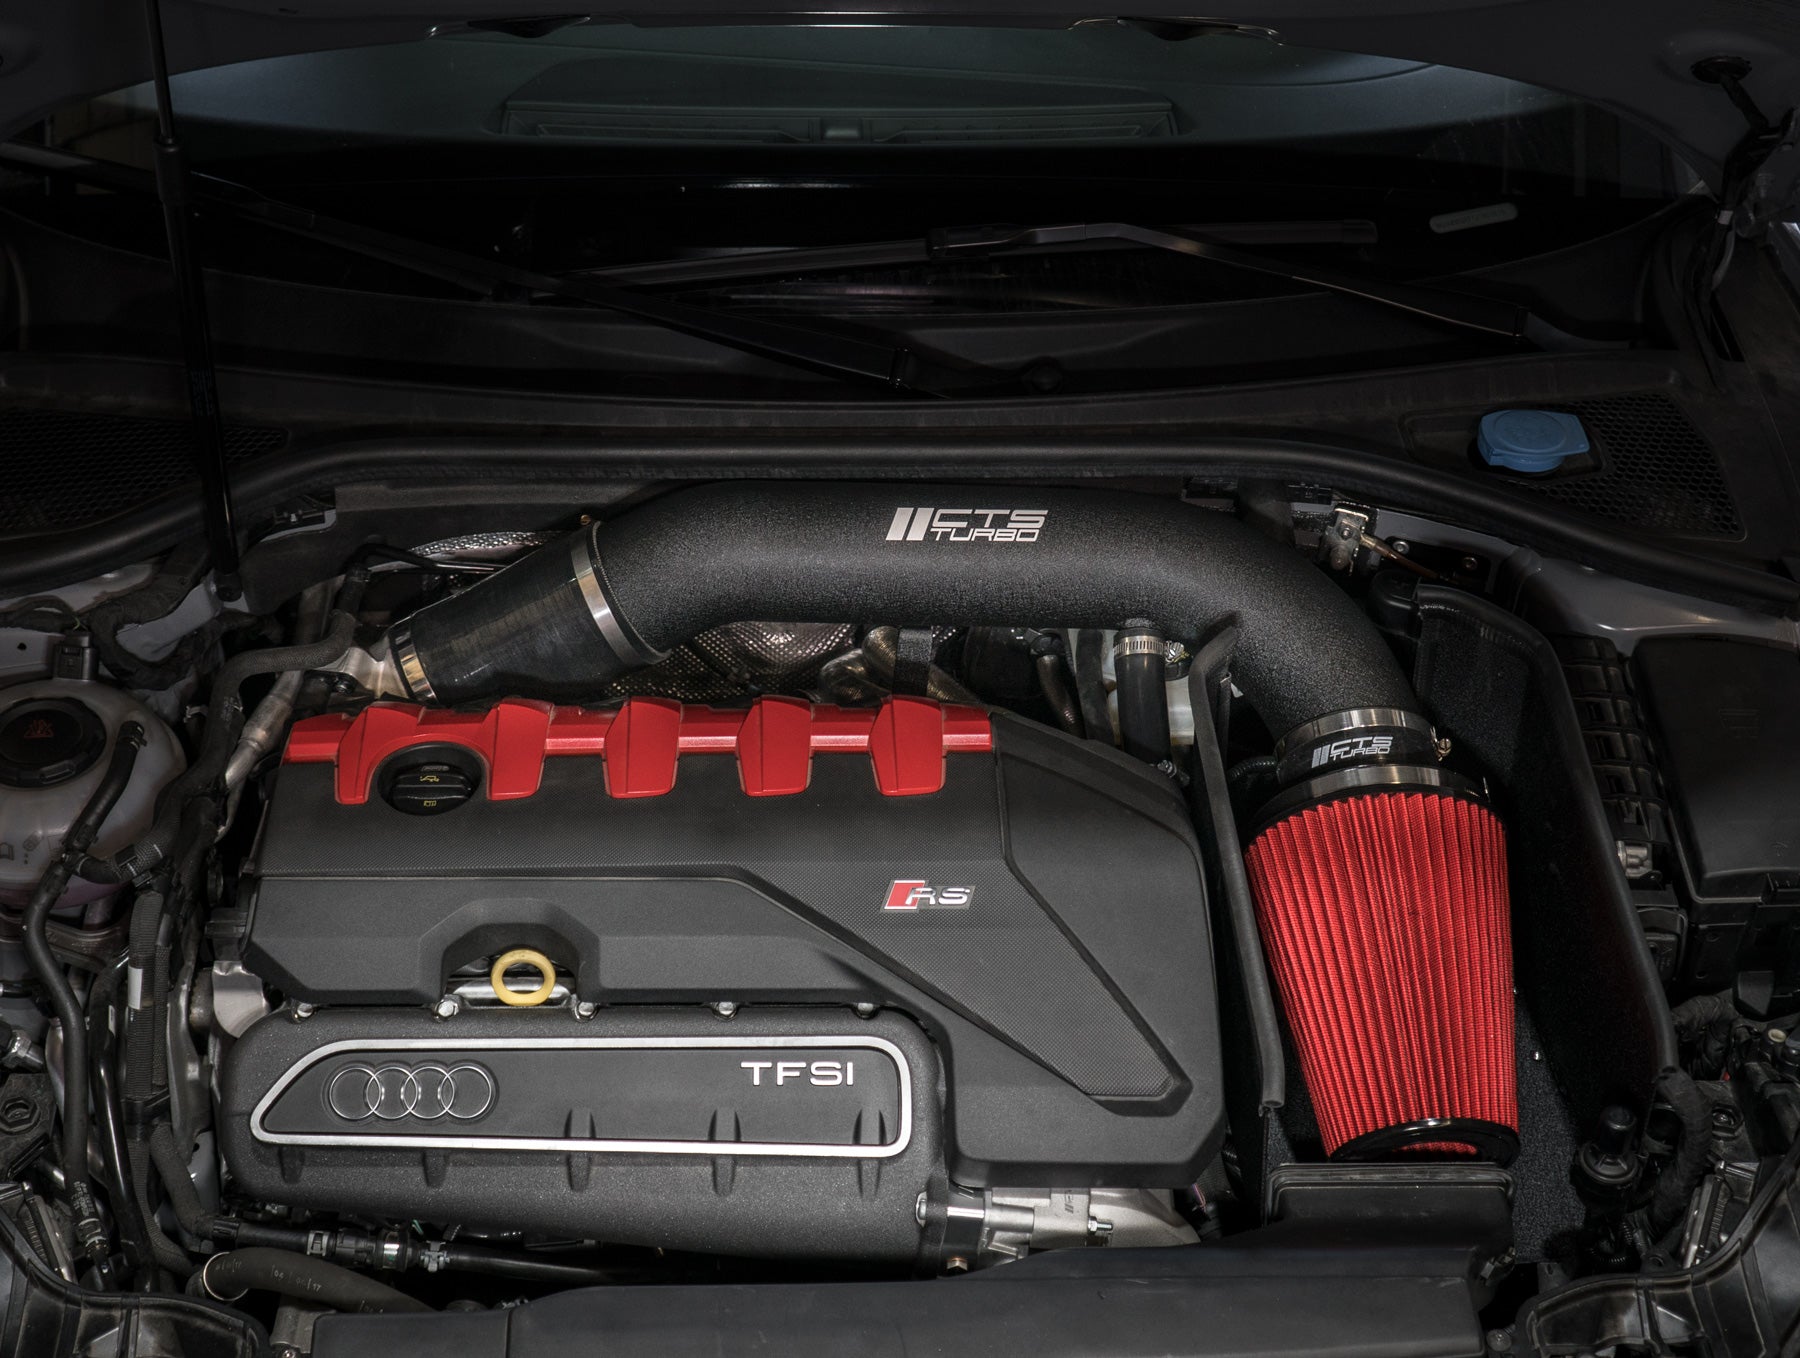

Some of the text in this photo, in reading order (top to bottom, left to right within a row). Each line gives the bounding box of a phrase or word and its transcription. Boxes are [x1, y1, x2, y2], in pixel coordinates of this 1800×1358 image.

[932, 508, 1049, 529] CTS
[930, 528, 1040, 542] TURBO
[1329, 747, 1390, 761] TURBO
[1330, 736, 1393, 754] CTS
[905, 887, 970, 905] RS
[740, 1061, 854, 1086] TFSI
